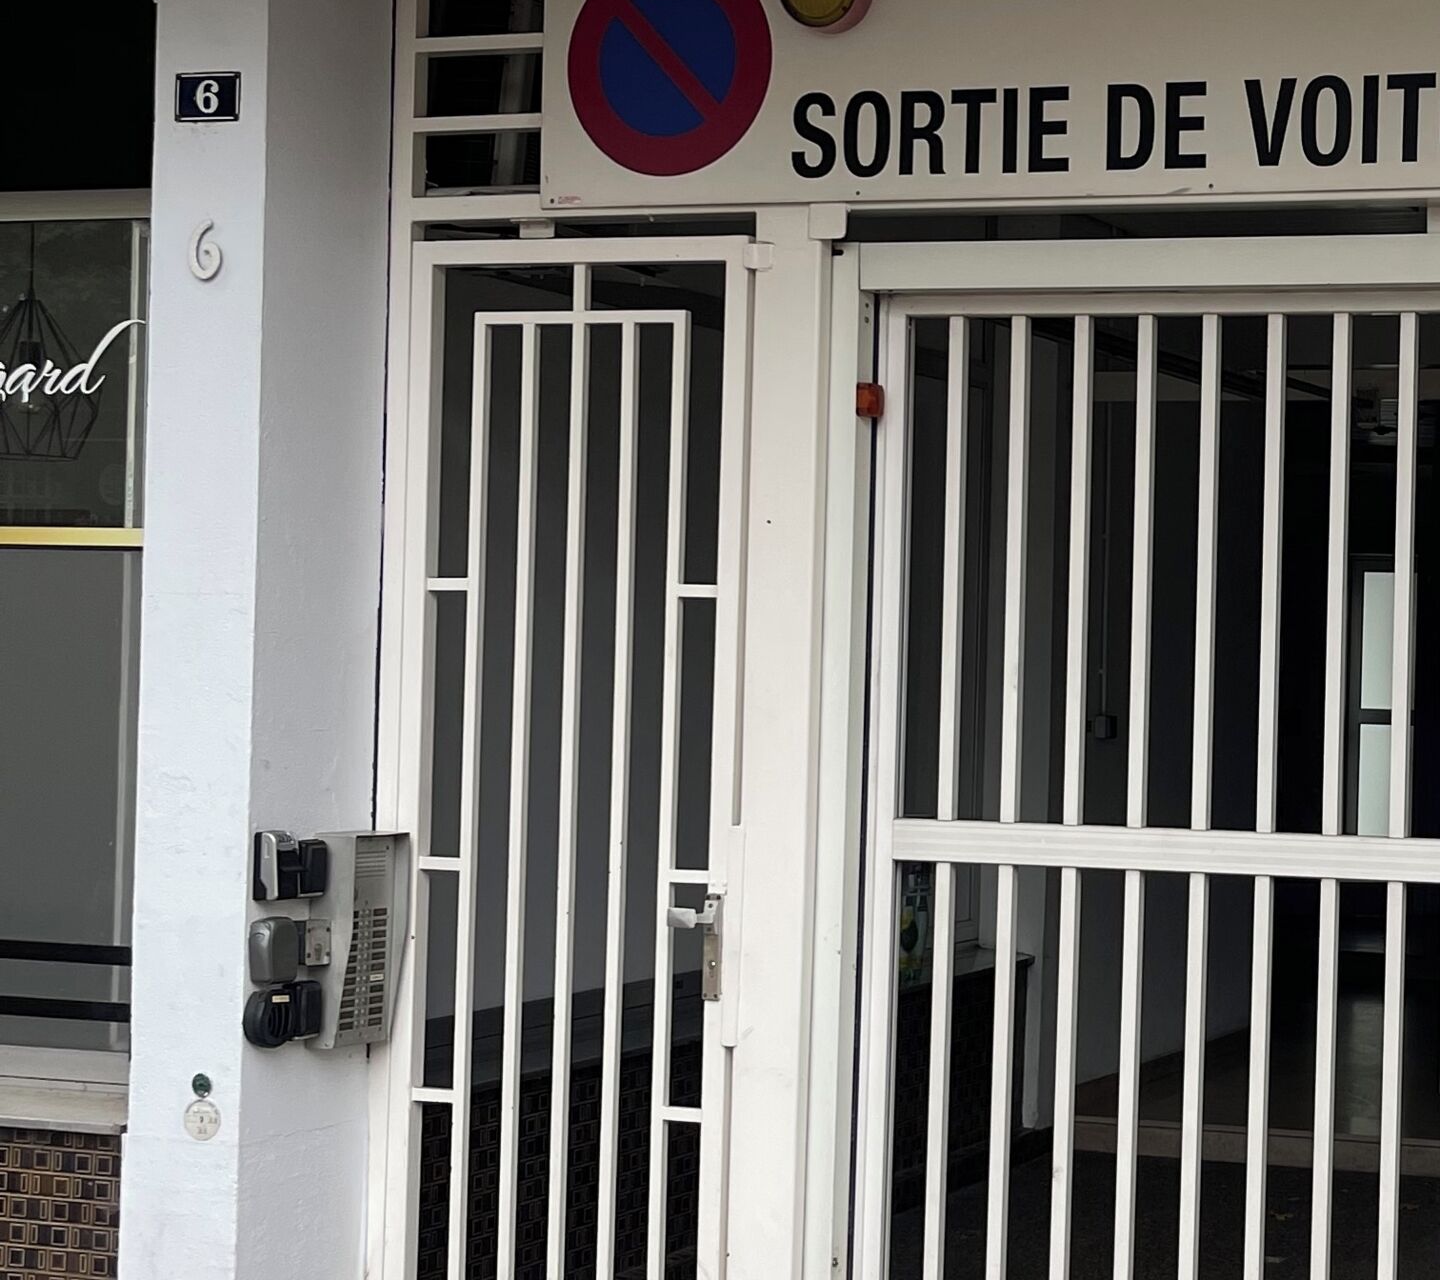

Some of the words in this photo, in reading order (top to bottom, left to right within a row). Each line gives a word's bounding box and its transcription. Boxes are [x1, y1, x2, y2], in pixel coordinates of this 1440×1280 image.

[195, 79, 220, 114] 6
[791, 85, 1070, 179] SORTIE
[1106, 81, 1207, 171] DE
[190, 219, 223, 281] 6
[0, 320, 146, 401] ard
